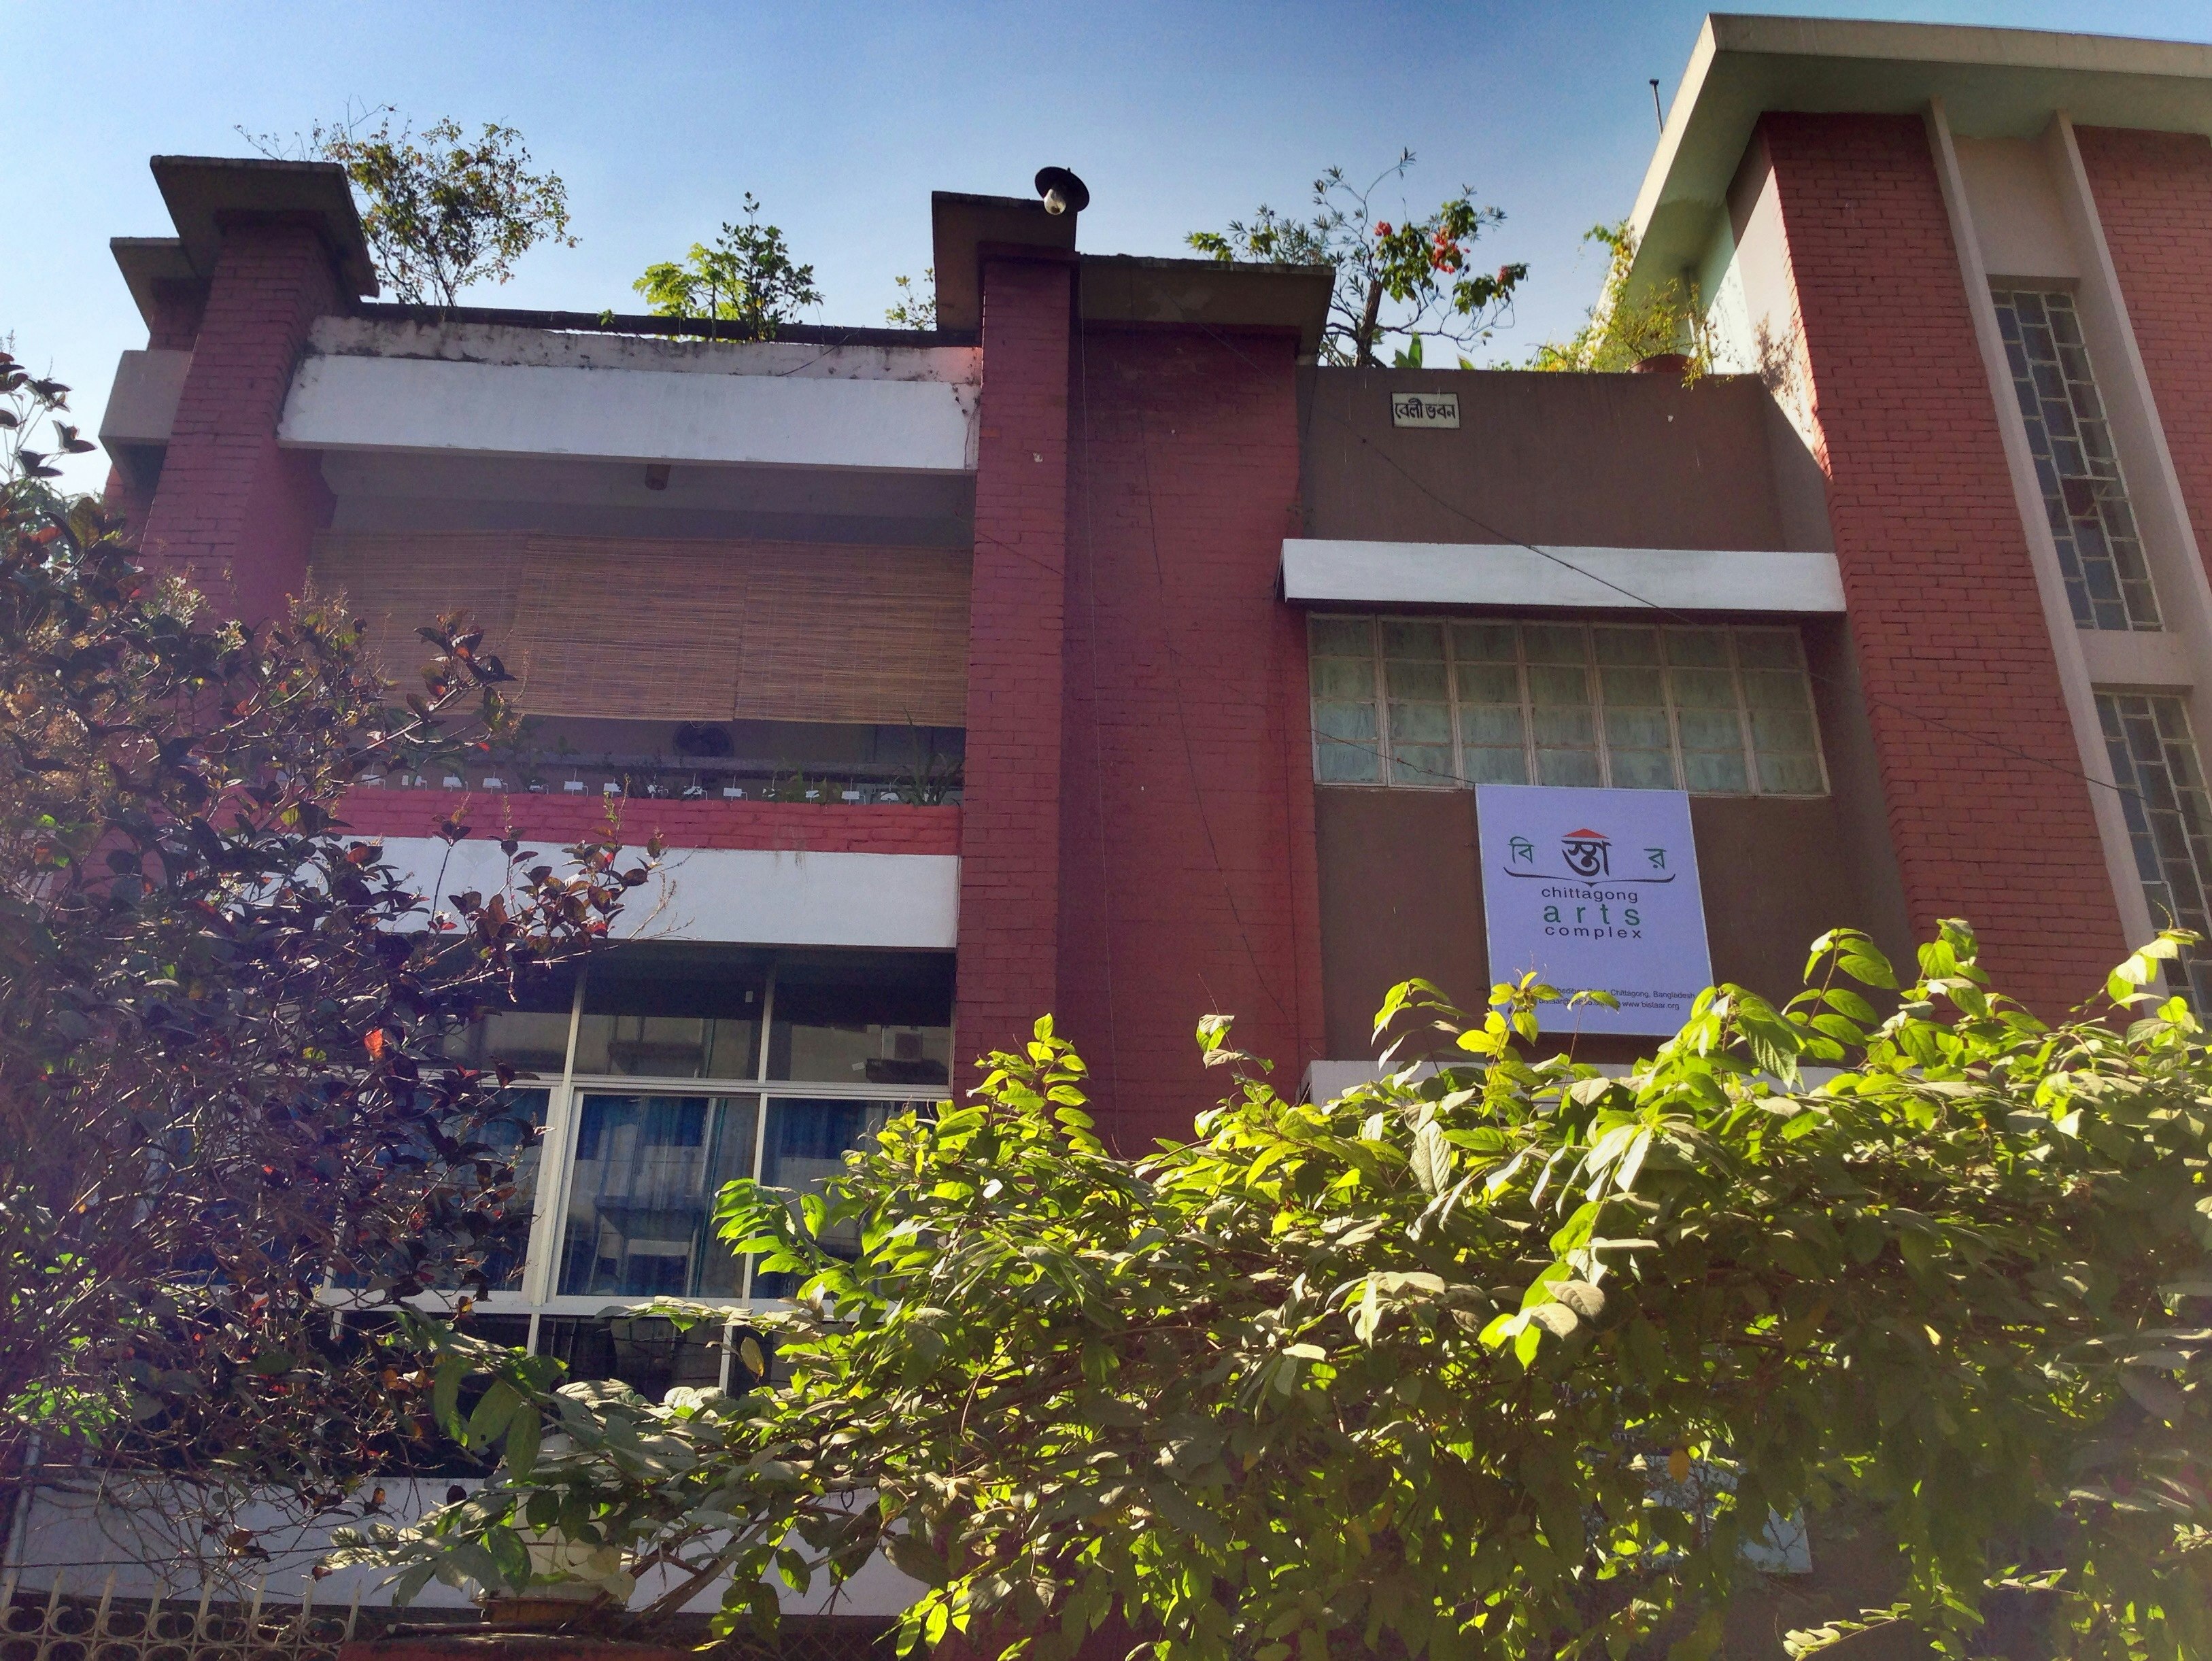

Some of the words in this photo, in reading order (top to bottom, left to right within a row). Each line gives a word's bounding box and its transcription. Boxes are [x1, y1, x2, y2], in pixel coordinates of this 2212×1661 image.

[1395, 397, 1423, 419] বেলী
[1425, 403, 1455, 419] ভবন
[1541, 887, 1639, 904] chittagong
[1543, 904, 1640, 926] arts
[1544, 925, 1642, 940] complex
[1610, 989, 1651, 998] Chittagong,
